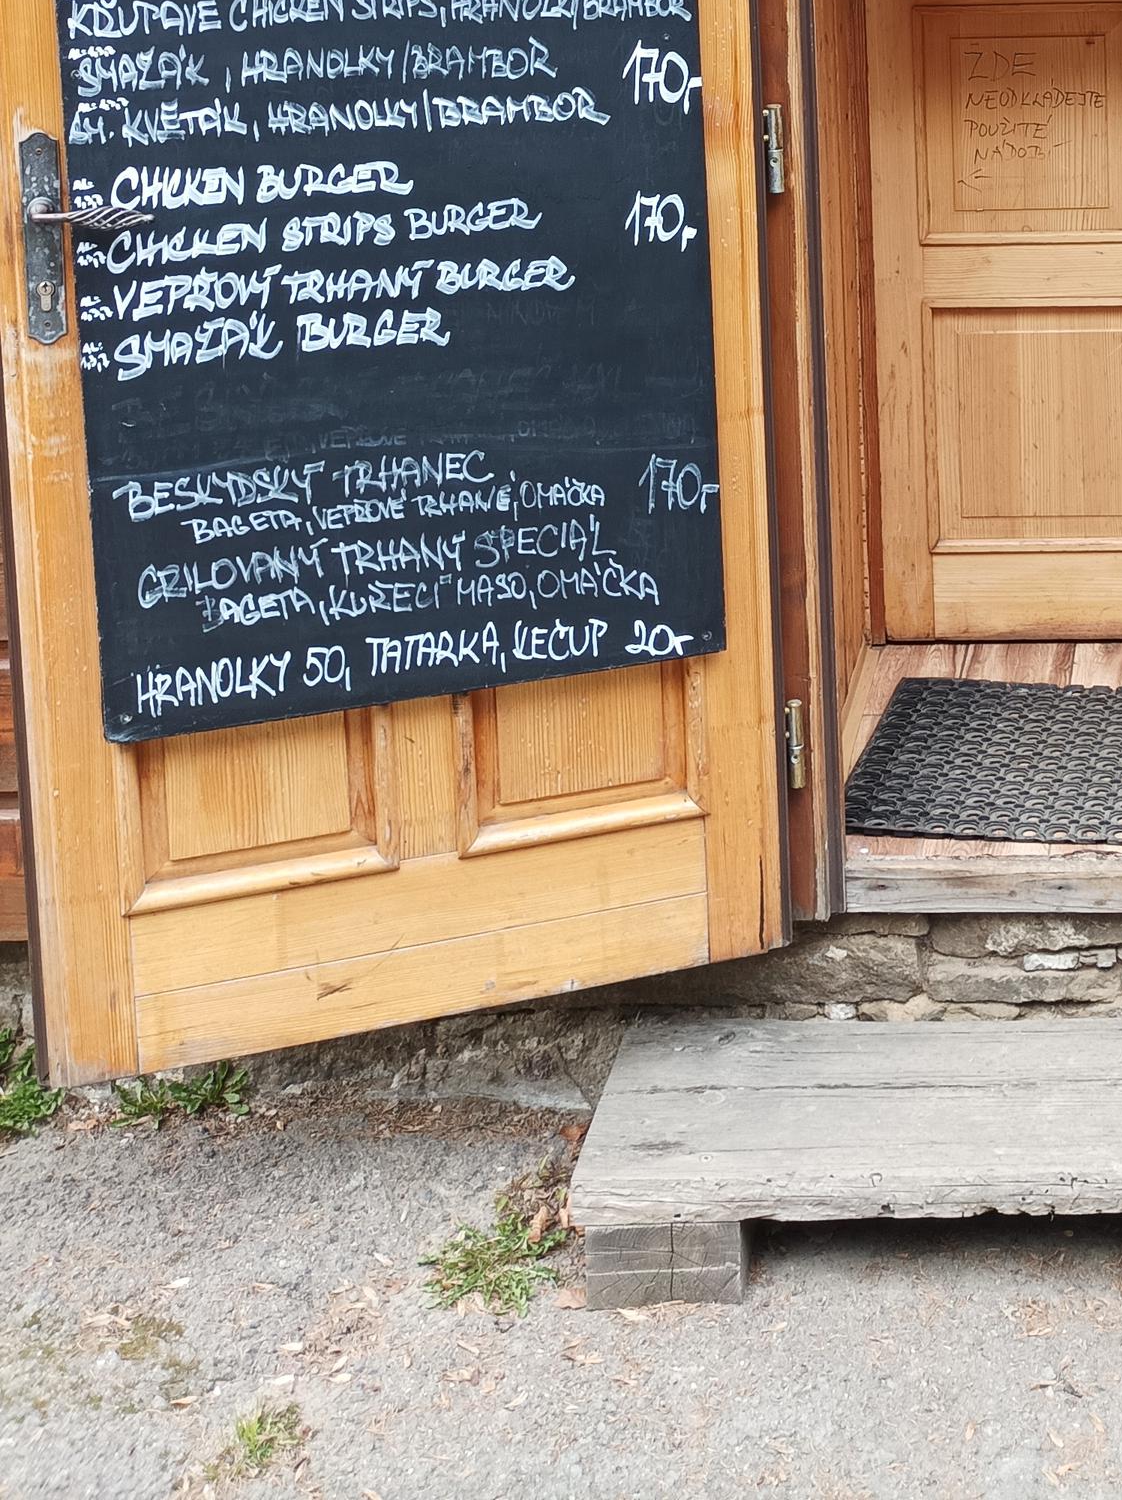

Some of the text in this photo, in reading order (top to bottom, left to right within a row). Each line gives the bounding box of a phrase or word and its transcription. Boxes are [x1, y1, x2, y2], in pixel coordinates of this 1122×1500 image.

[965, 78, 1106, 110] NEODKLÁDEJTE
[110, 166, 244, 210] CHICKEN
[256, 160, 414, 203] BURGER
[107, 217, 267, 274] CHICKEN
[282, 211, 396, 251] STRIPS
[403, 197, 542, 240] BURGER
[435, 255, 576, 295] BURGER
[297, 307, 450, 352] BURGER
[332, 450, 495, 497] TRHANEC
[138, 513, 617, 608] GRILOVANÝ TRHANÝ SPECIÁL
[537, 557, 660, 605] OMÁČKA
[136, 650, 292, 718] HRANOLKY
[512, 618, 608, 661] KEČUP
